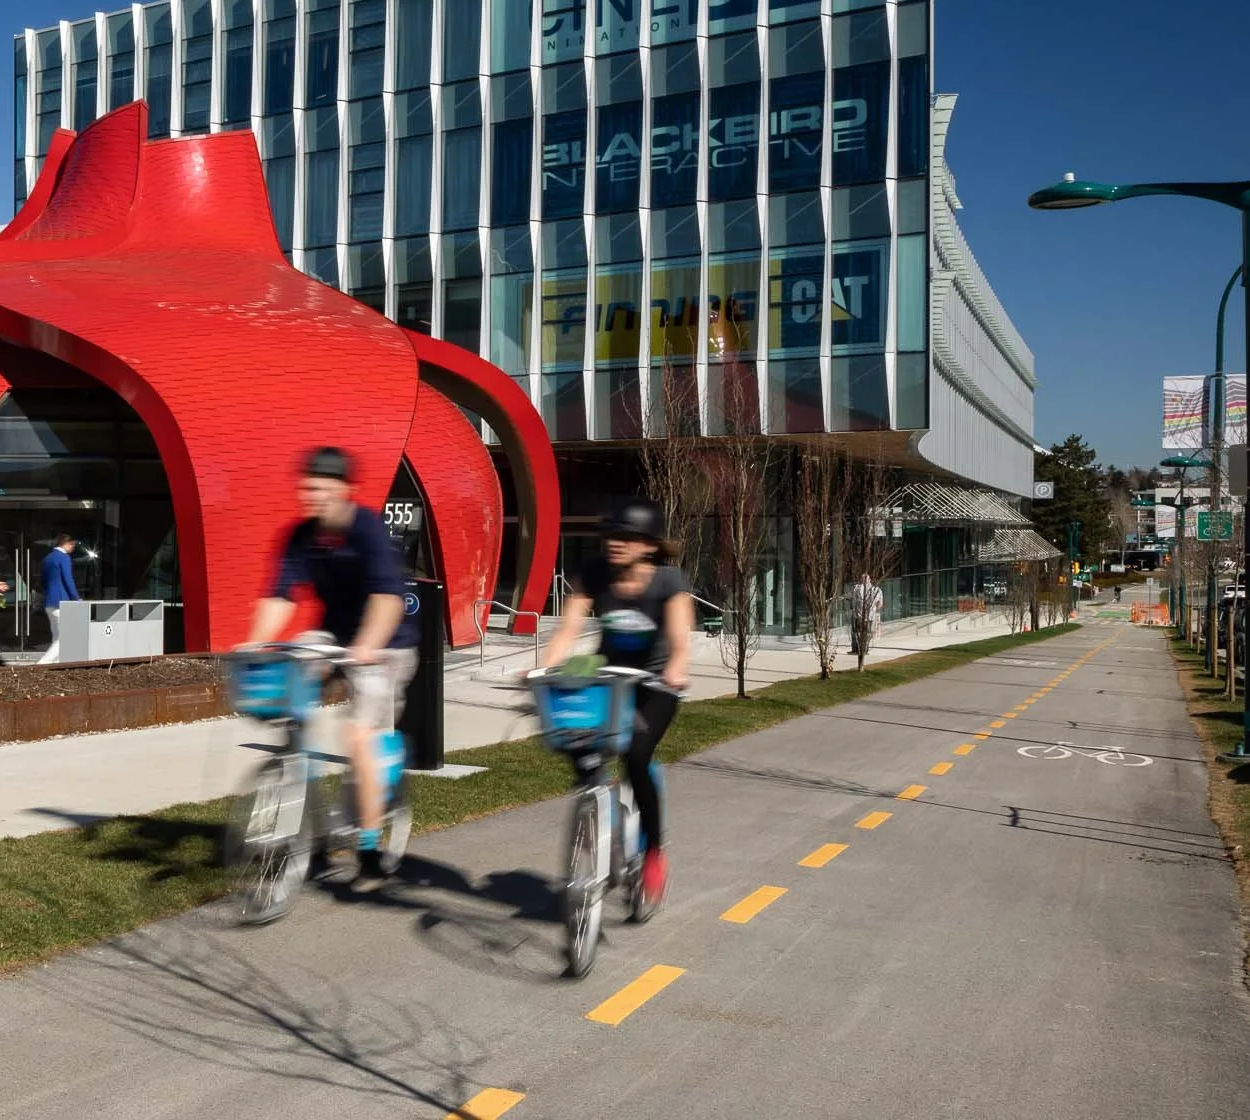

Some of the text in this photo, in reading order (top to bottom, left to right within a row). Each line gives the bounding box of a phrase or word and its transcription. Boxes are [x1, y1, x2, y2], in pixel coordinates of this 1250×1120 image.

[547, 17, 680, 51] NIATION
[543, 98, 868, 168] BLACKBIRD
[543, 129, 868, 191] NERACIVE
[792, 276, 869, 324] CAT
[384, 503, 413, 525] 555
